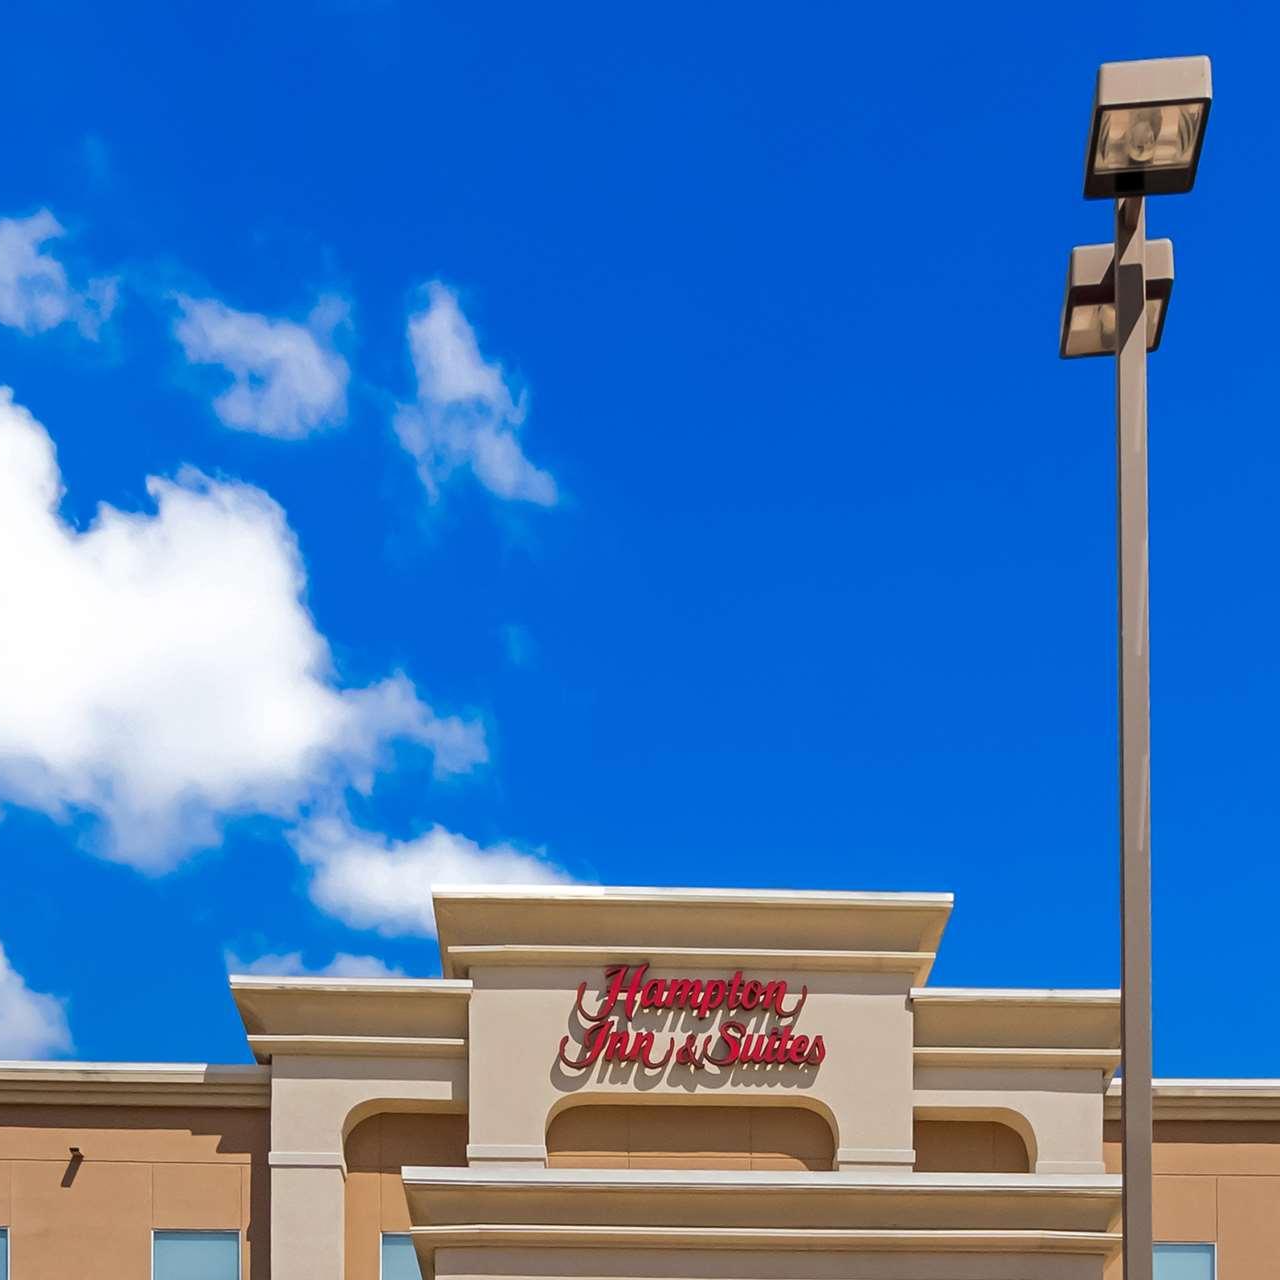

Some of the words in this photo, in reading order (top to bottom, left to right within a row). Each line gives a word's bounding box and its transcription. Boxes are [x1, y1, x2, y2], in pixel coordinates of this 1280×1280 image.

[577, 961, 808, 1022] Hampton
[559, 1020, 675, 1070] Inn
[675, 1033, 705, 1069] &
[703, 1020, 826, 1067] Suites
